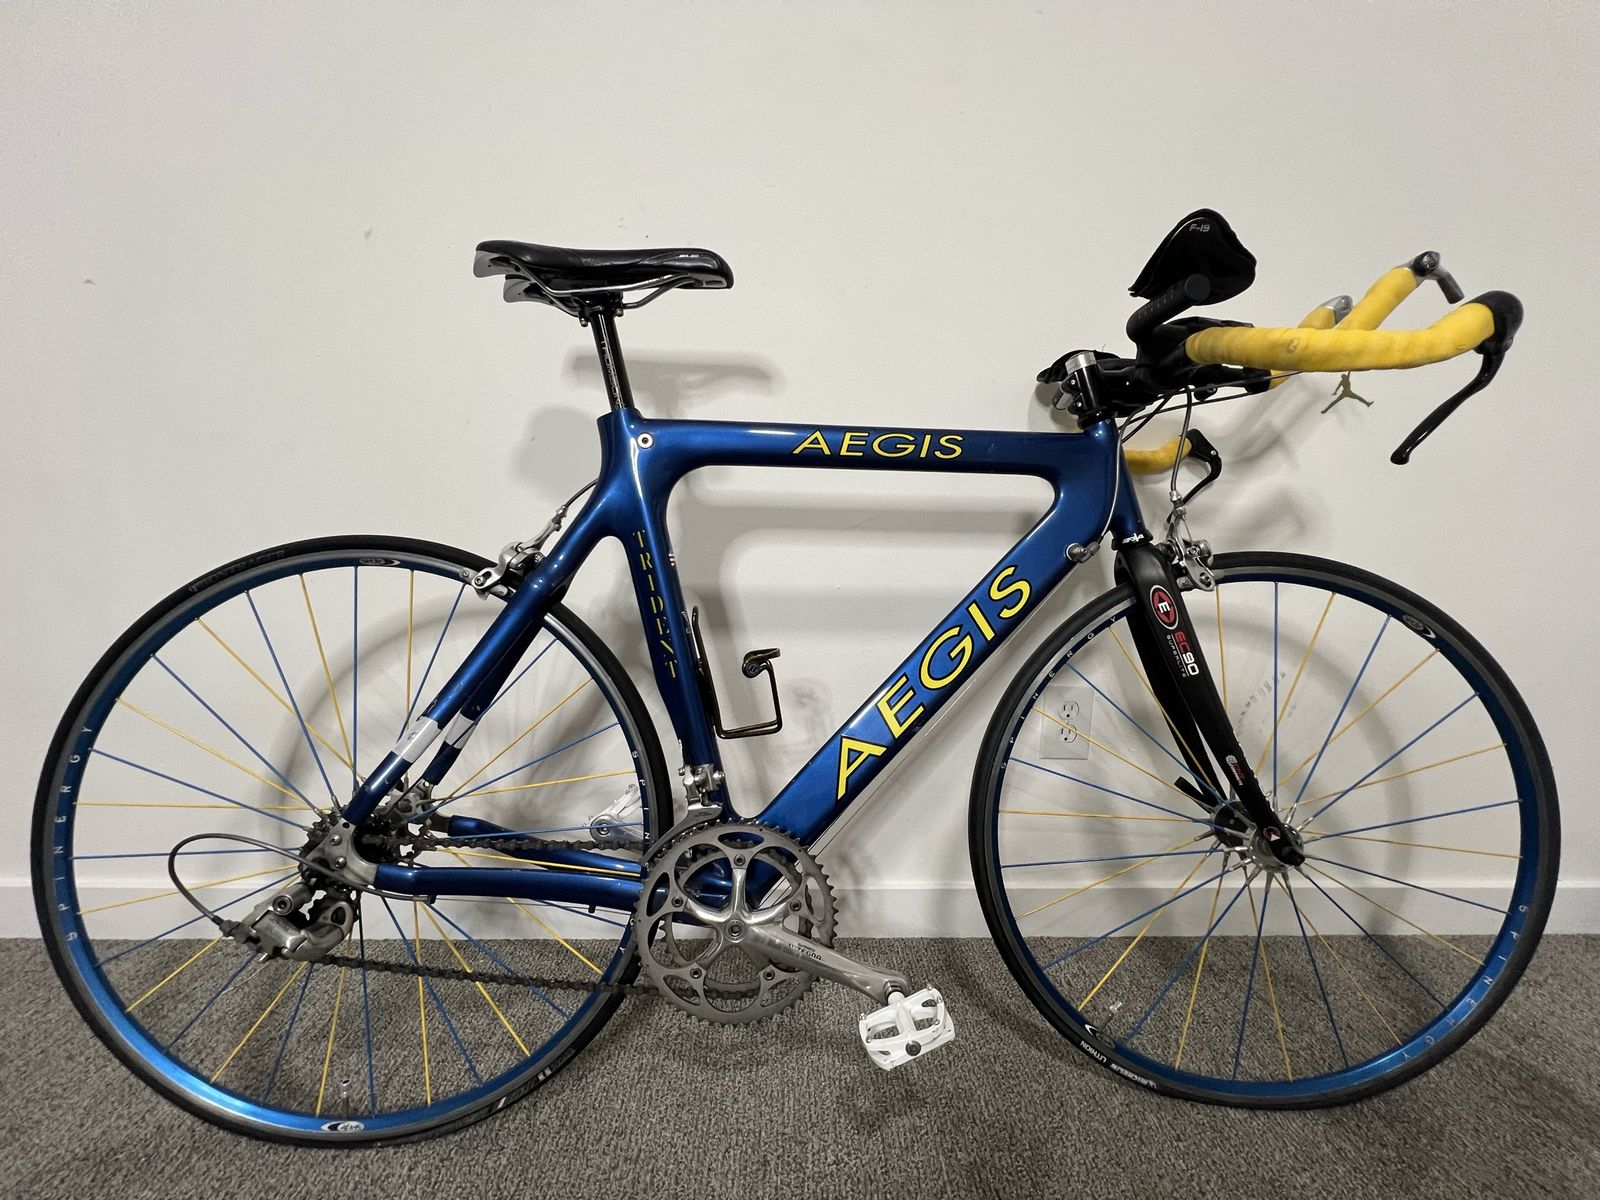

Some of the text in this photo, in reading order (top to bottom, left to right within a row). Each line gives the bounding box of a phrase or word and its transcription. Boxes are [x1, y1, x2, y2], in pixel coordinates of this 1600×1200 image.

[1189, 223, 1210, 232] F-19
[791, 429, 965, 460] AEGIS
[632, 529, 678, 679] TRIDENT
[1166, 634, 1187, 678] SUPERLITE
[1174, 631, 1200, 676] EC90
[836, 564, 1032, 801] AEGIS
[52, 726, 93, 942] SPINERGY
[1080, 1040, 1108, 1063] LITHION
